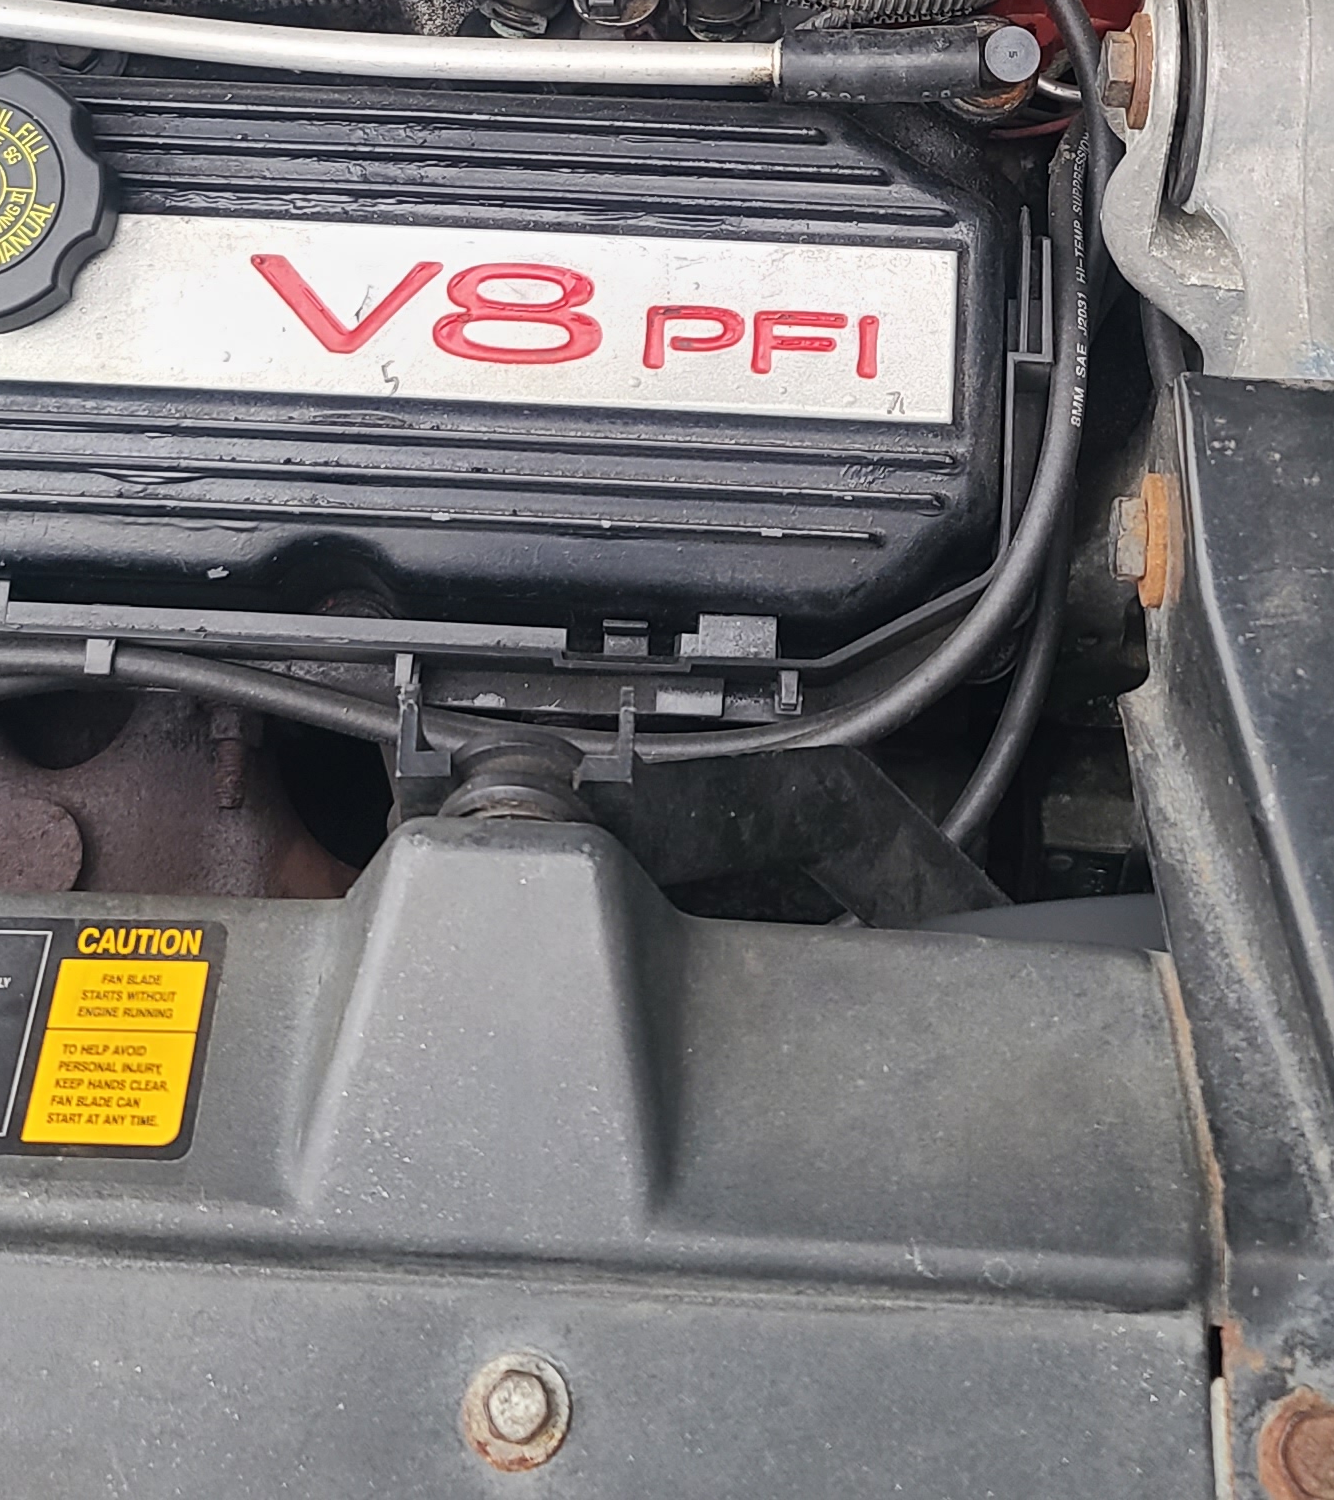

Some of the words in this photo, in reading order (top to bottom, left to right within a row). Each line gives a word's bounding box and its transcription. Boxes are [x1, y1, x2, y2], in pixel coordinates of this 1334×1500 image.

[14, 122, 49, 162] FILL
[3, 146, 22, 165] SG
[1074, 220, 1087, 284] HI-TEMP
[250, 254, 604, 365] V8
[642, 305, 880, 379] PFI
[1077, 292, 1088, 336] J2031
[1076, 342, 1087, 379] SAE
[1071, 386, 1086, 427] 8MM
[77, 927, 203, 956] CAUTION
[101, 974, 122, 984] FAN
[126, 974, 162, 985] BLADE
[81, 990, 123, 1001] STARTS
[127, 991, 177, 1002] WITHOUT
[77, 1007, 118, 1018] ENGINE
[122, 1008, 174, 1019] RUNNING
[62, 1044, 78, 1054] TO
[80, 1044, 110, 1055] HELP
[112, 1045, 147, 1056] AVOID
[58, 1061, 117, 1073] PERSONAL
[54, 1078, 84, 1089] KEEP
[87, 1078, 126, 1090] HANDS
[51, 1095, 74, 1106] FAN
[76, 1096, 113, 1108] BLADE
[116, 1097, 141, 1108] CAN
[47, 1113, 83, 1124] START
[85, 1113, 100, 1124] AT
[103, 1114, 127, 1125] ANY
